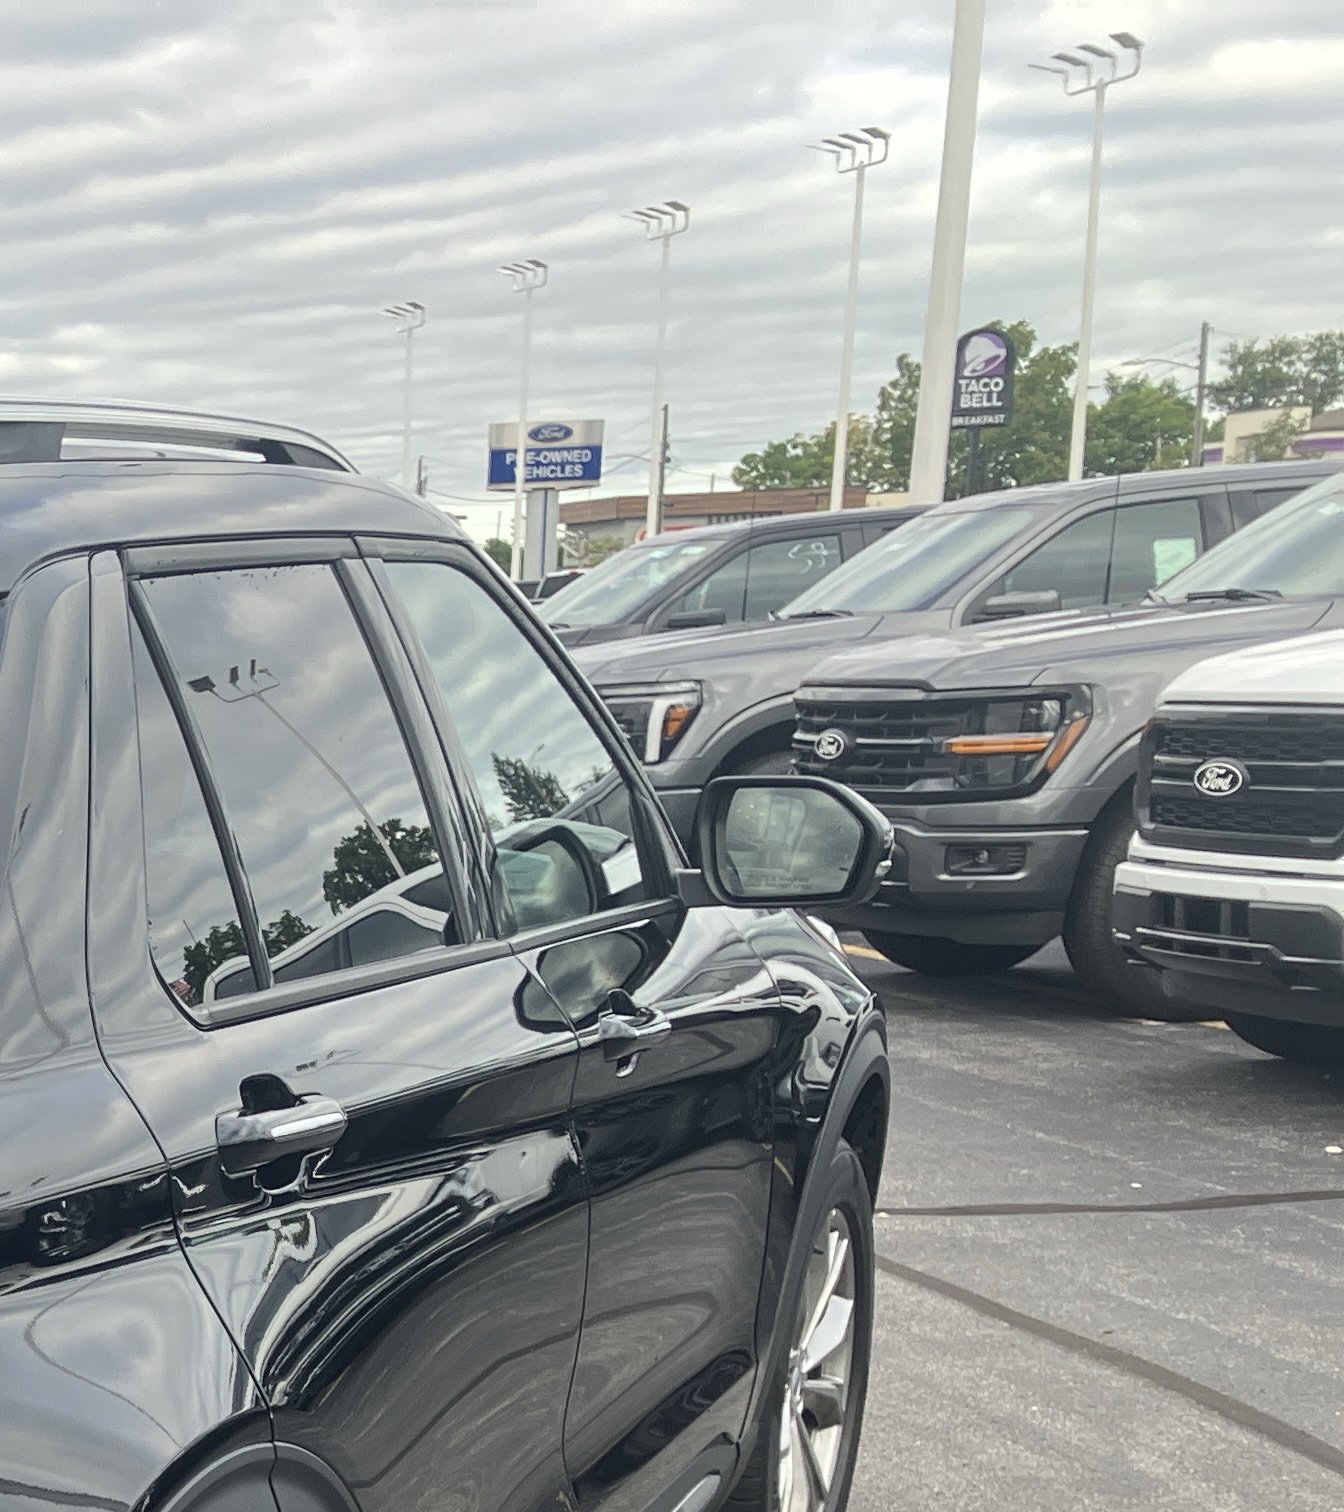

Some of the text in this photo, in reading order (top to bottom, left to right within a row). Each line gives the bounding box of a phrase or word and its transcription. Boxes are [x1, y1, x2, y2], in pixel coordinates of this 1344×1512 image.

[958, 377, 1005, 393] TACO
[960, 392, 1003, 409] BELL
[952, 414, 1006, 427] BREAKFAST
[537, 425, 568, 442] Ford
[505, 449, 592, 465] PE-OWNED
[1201, 766, 1234, 791] Ford
